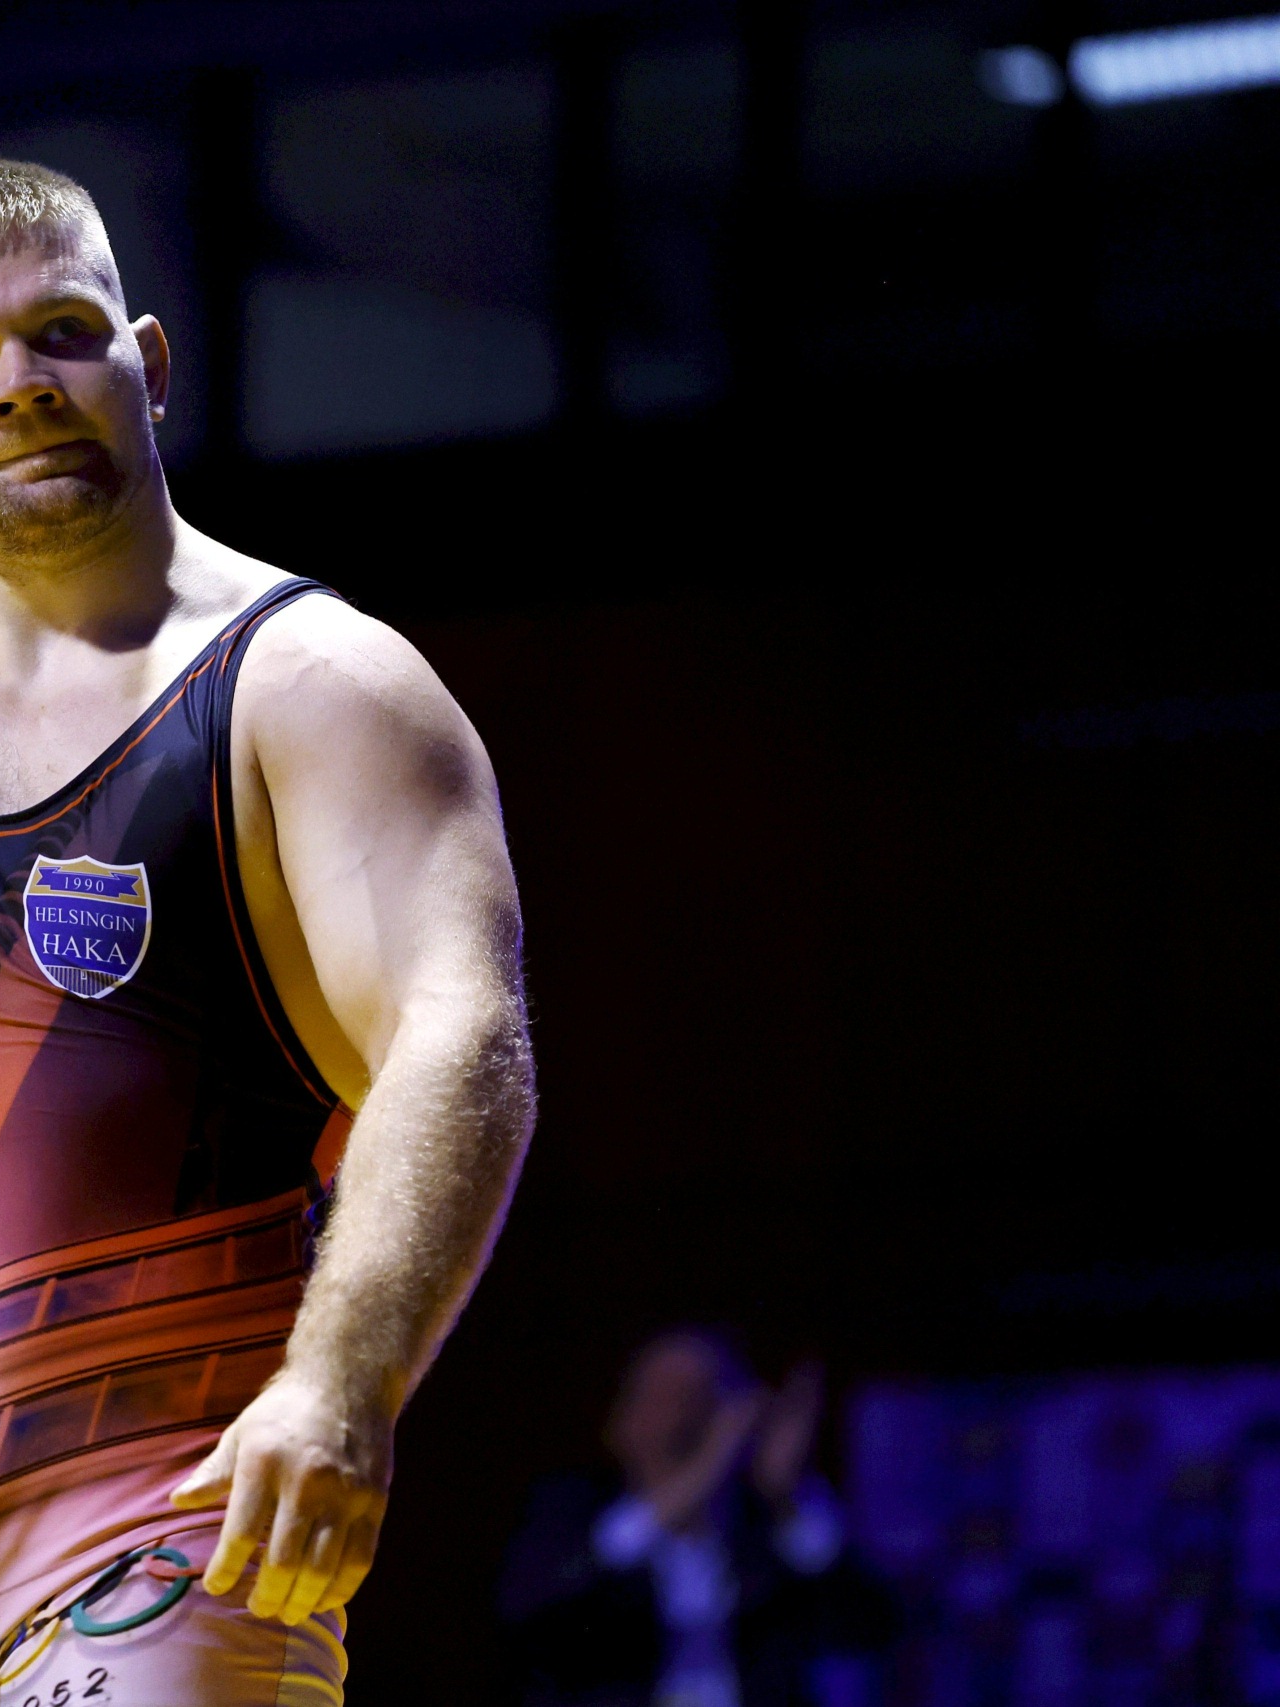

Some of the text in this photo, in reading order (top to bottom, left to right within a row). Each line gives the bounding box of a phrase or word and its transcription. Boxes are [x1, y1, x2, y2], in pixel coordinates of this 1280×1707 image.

[64, 876, 105, 893] 1990
[35, 906, 136, 933] HELSINGIN
[42, 932, 128, 966] HAKA
